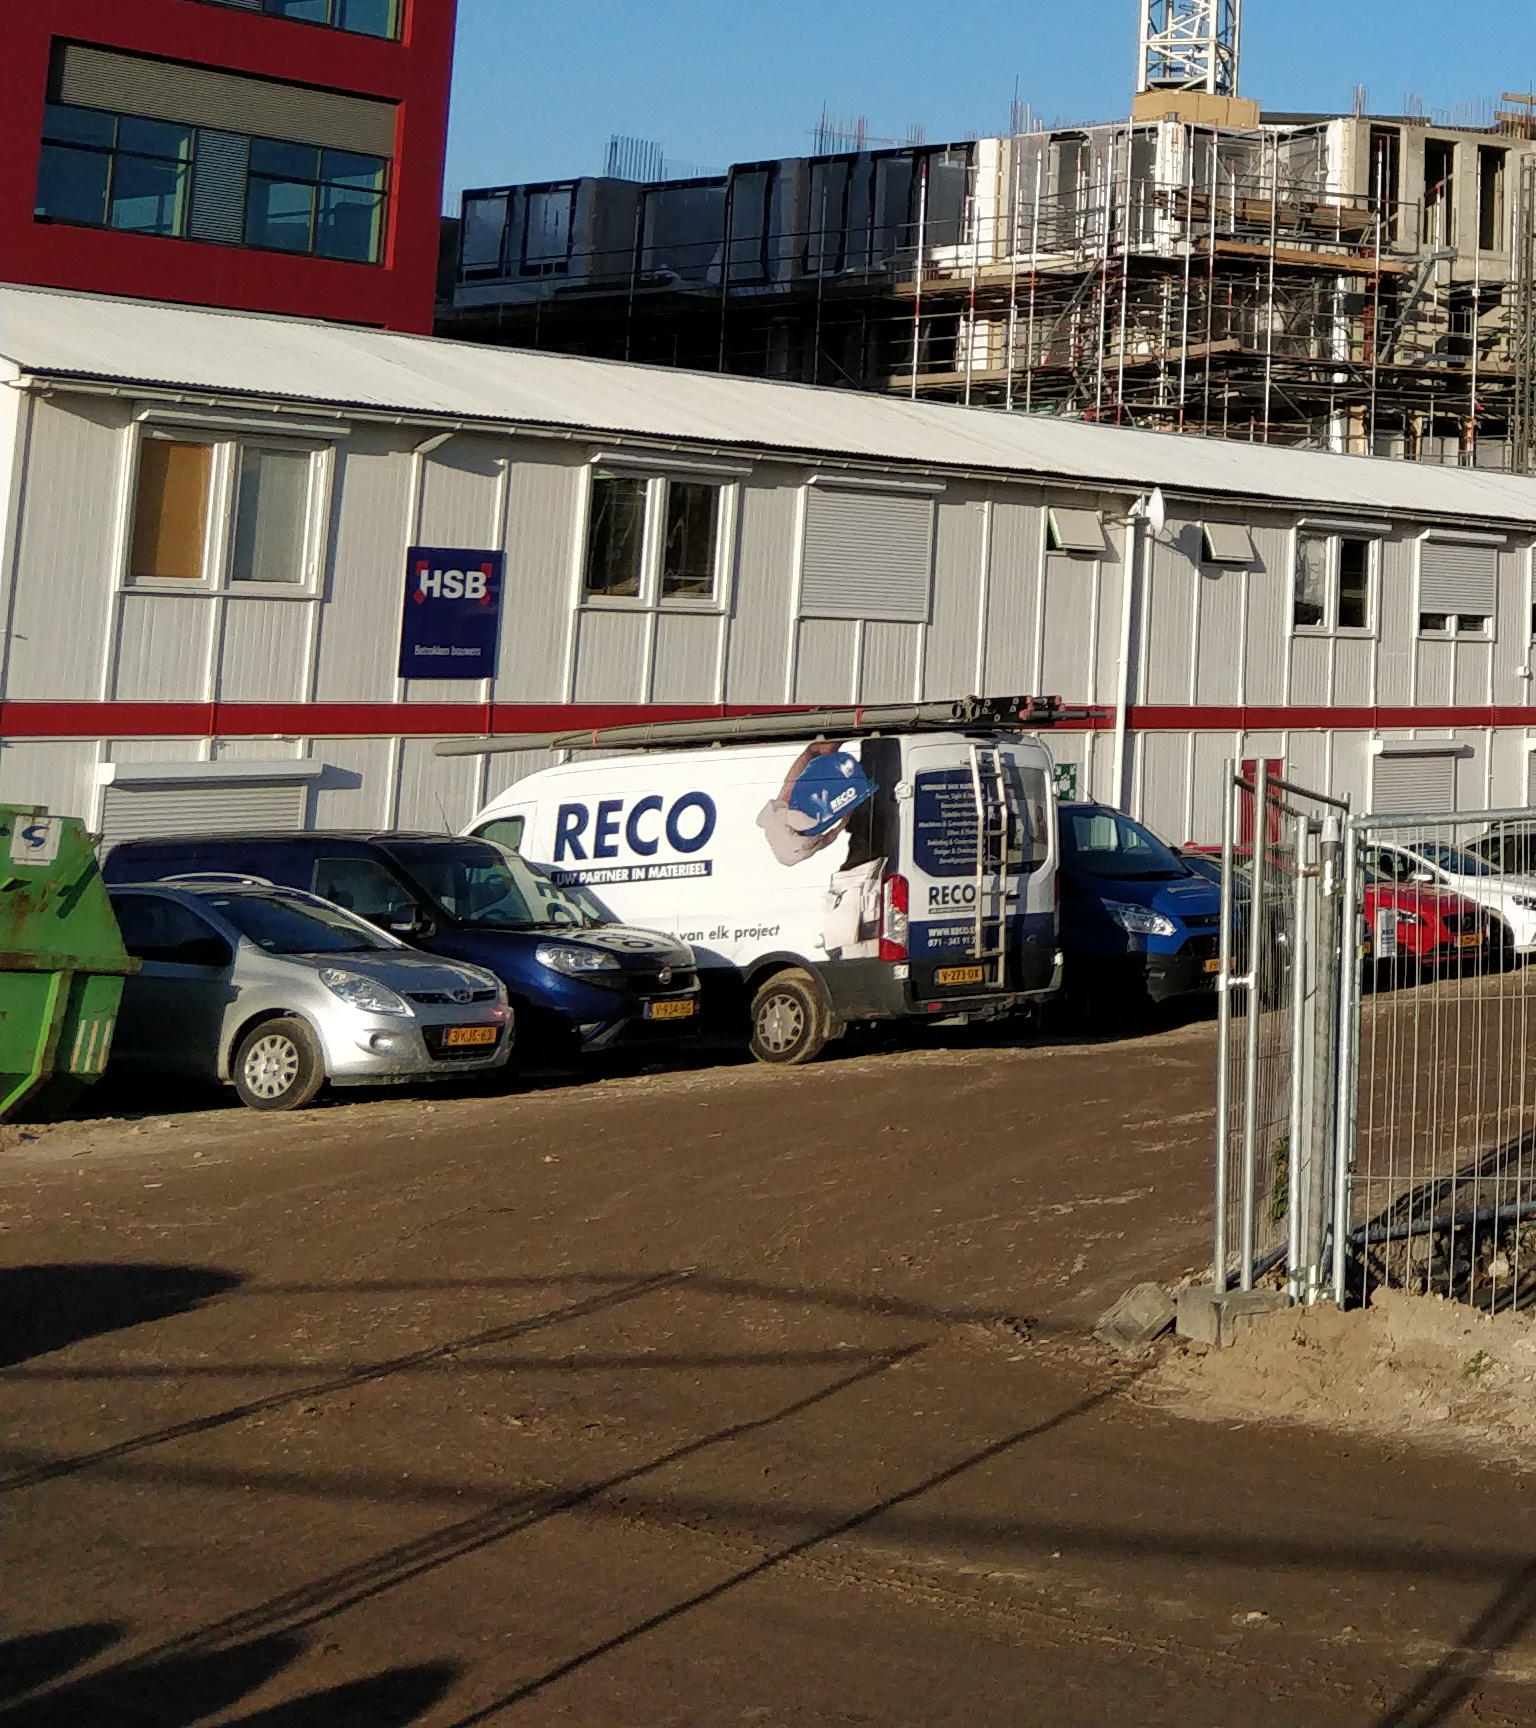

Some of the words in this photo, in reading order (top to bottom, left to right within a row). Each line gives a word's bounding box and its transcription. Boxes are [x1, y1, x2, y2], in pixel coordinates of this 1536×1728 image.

[420, 569, 487, 599] HSB
[553, 790, 717, 863] RECO
[556, 872, 577, 886] UW
[579, 869, 630, 884] PARTNER
[631, 867, 646, 880] IN
[648, 862, 709, 879] MATERIEEL
[928, 883, 977, 906] RECO
[679, 930, 704, 942] van
[708, 924, 730, 940] elk
[734, 923, 781, 942] project
